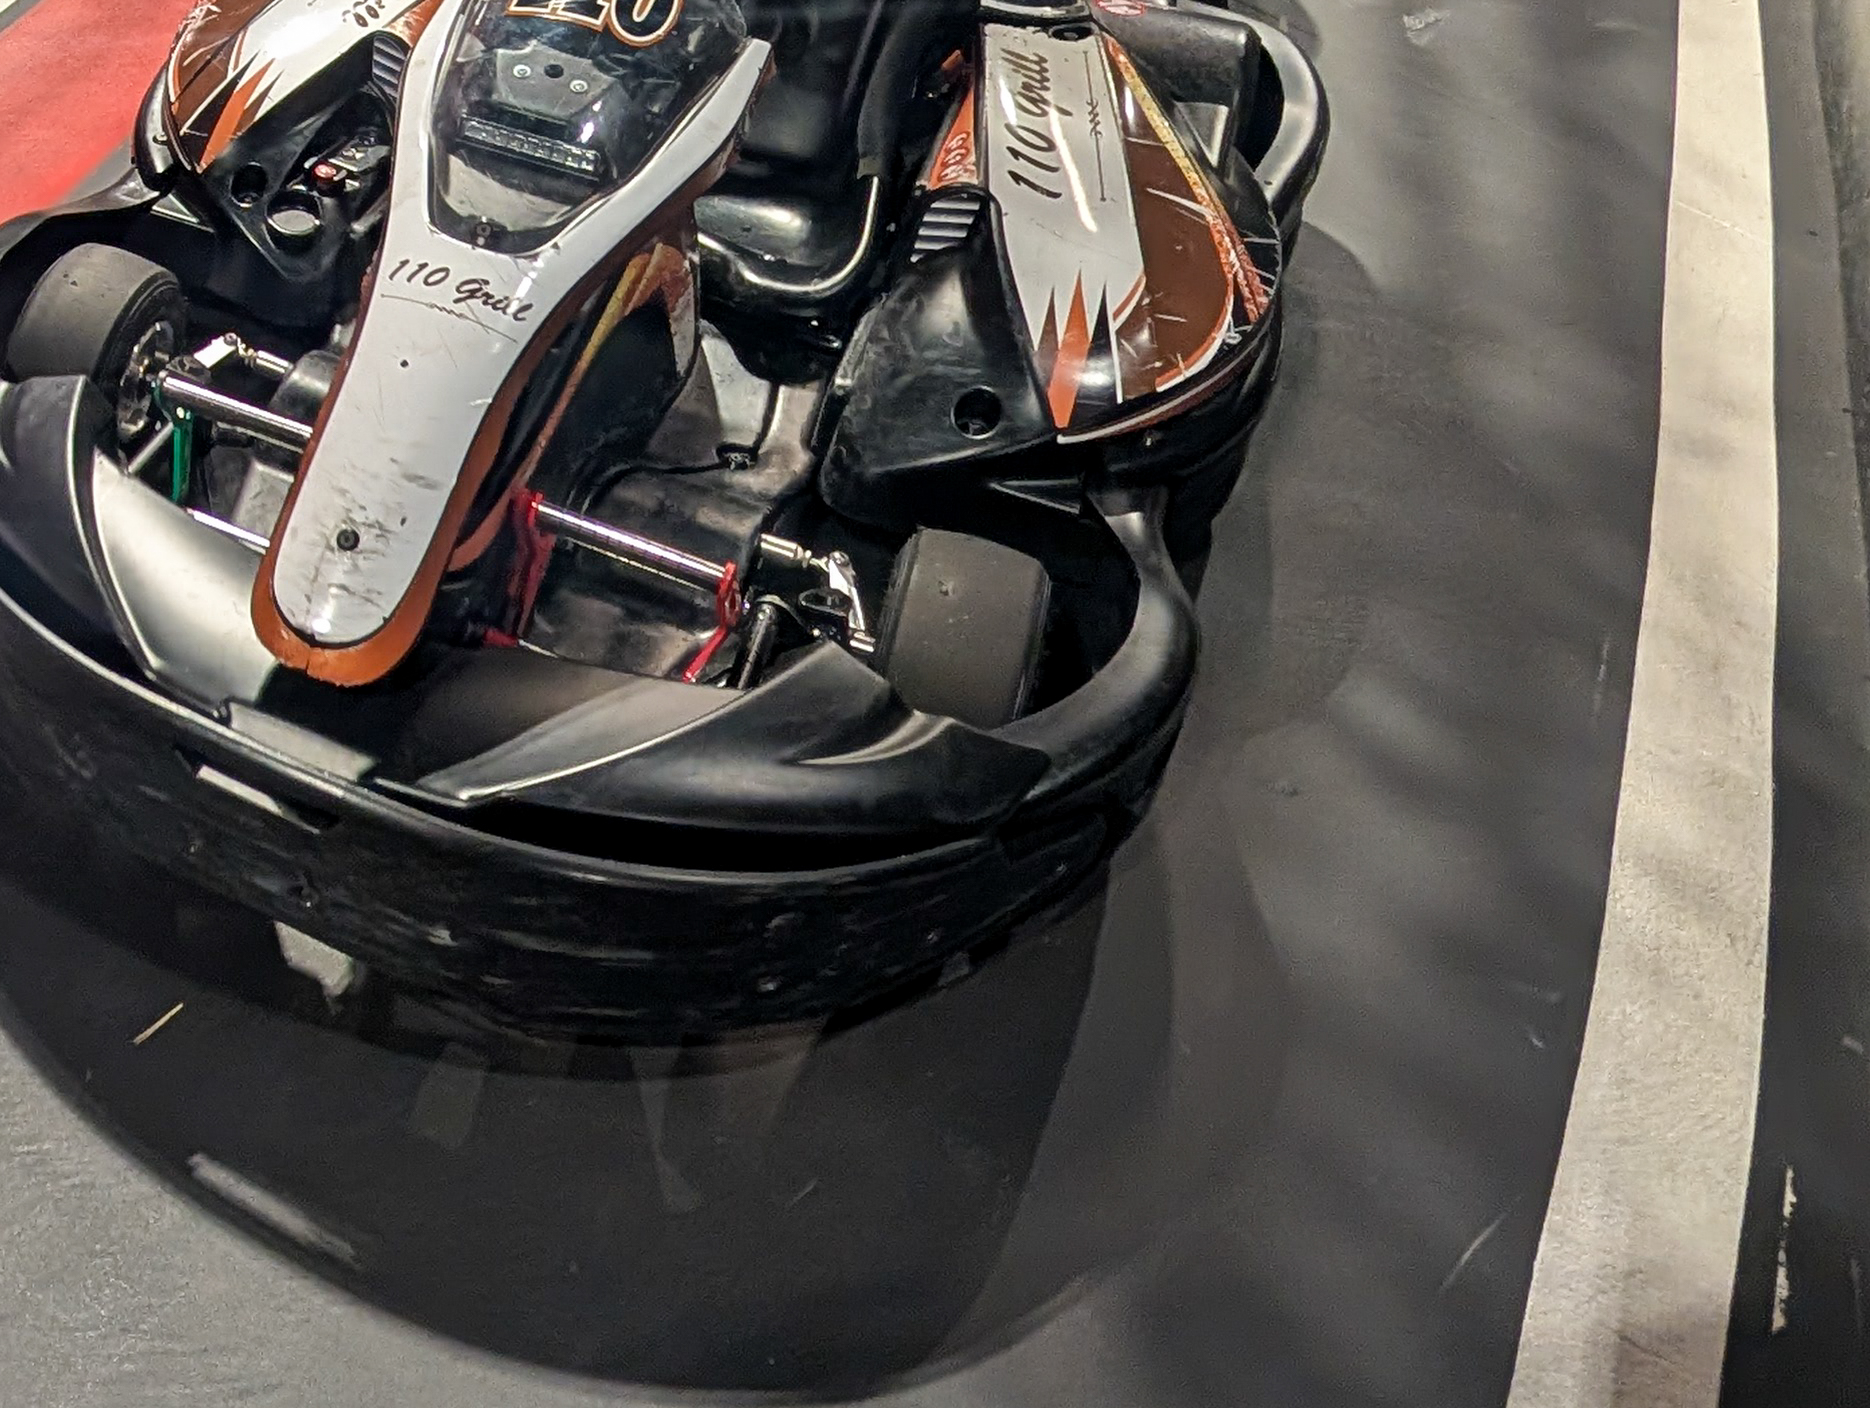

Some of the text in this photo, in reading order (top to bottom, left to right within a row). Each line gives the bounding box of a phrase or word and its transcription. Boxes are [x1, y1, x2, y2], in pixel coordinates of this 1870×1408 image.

[1002, 121, 1064, 200] 110
[387, 257, 537, 323] 110 Grill
